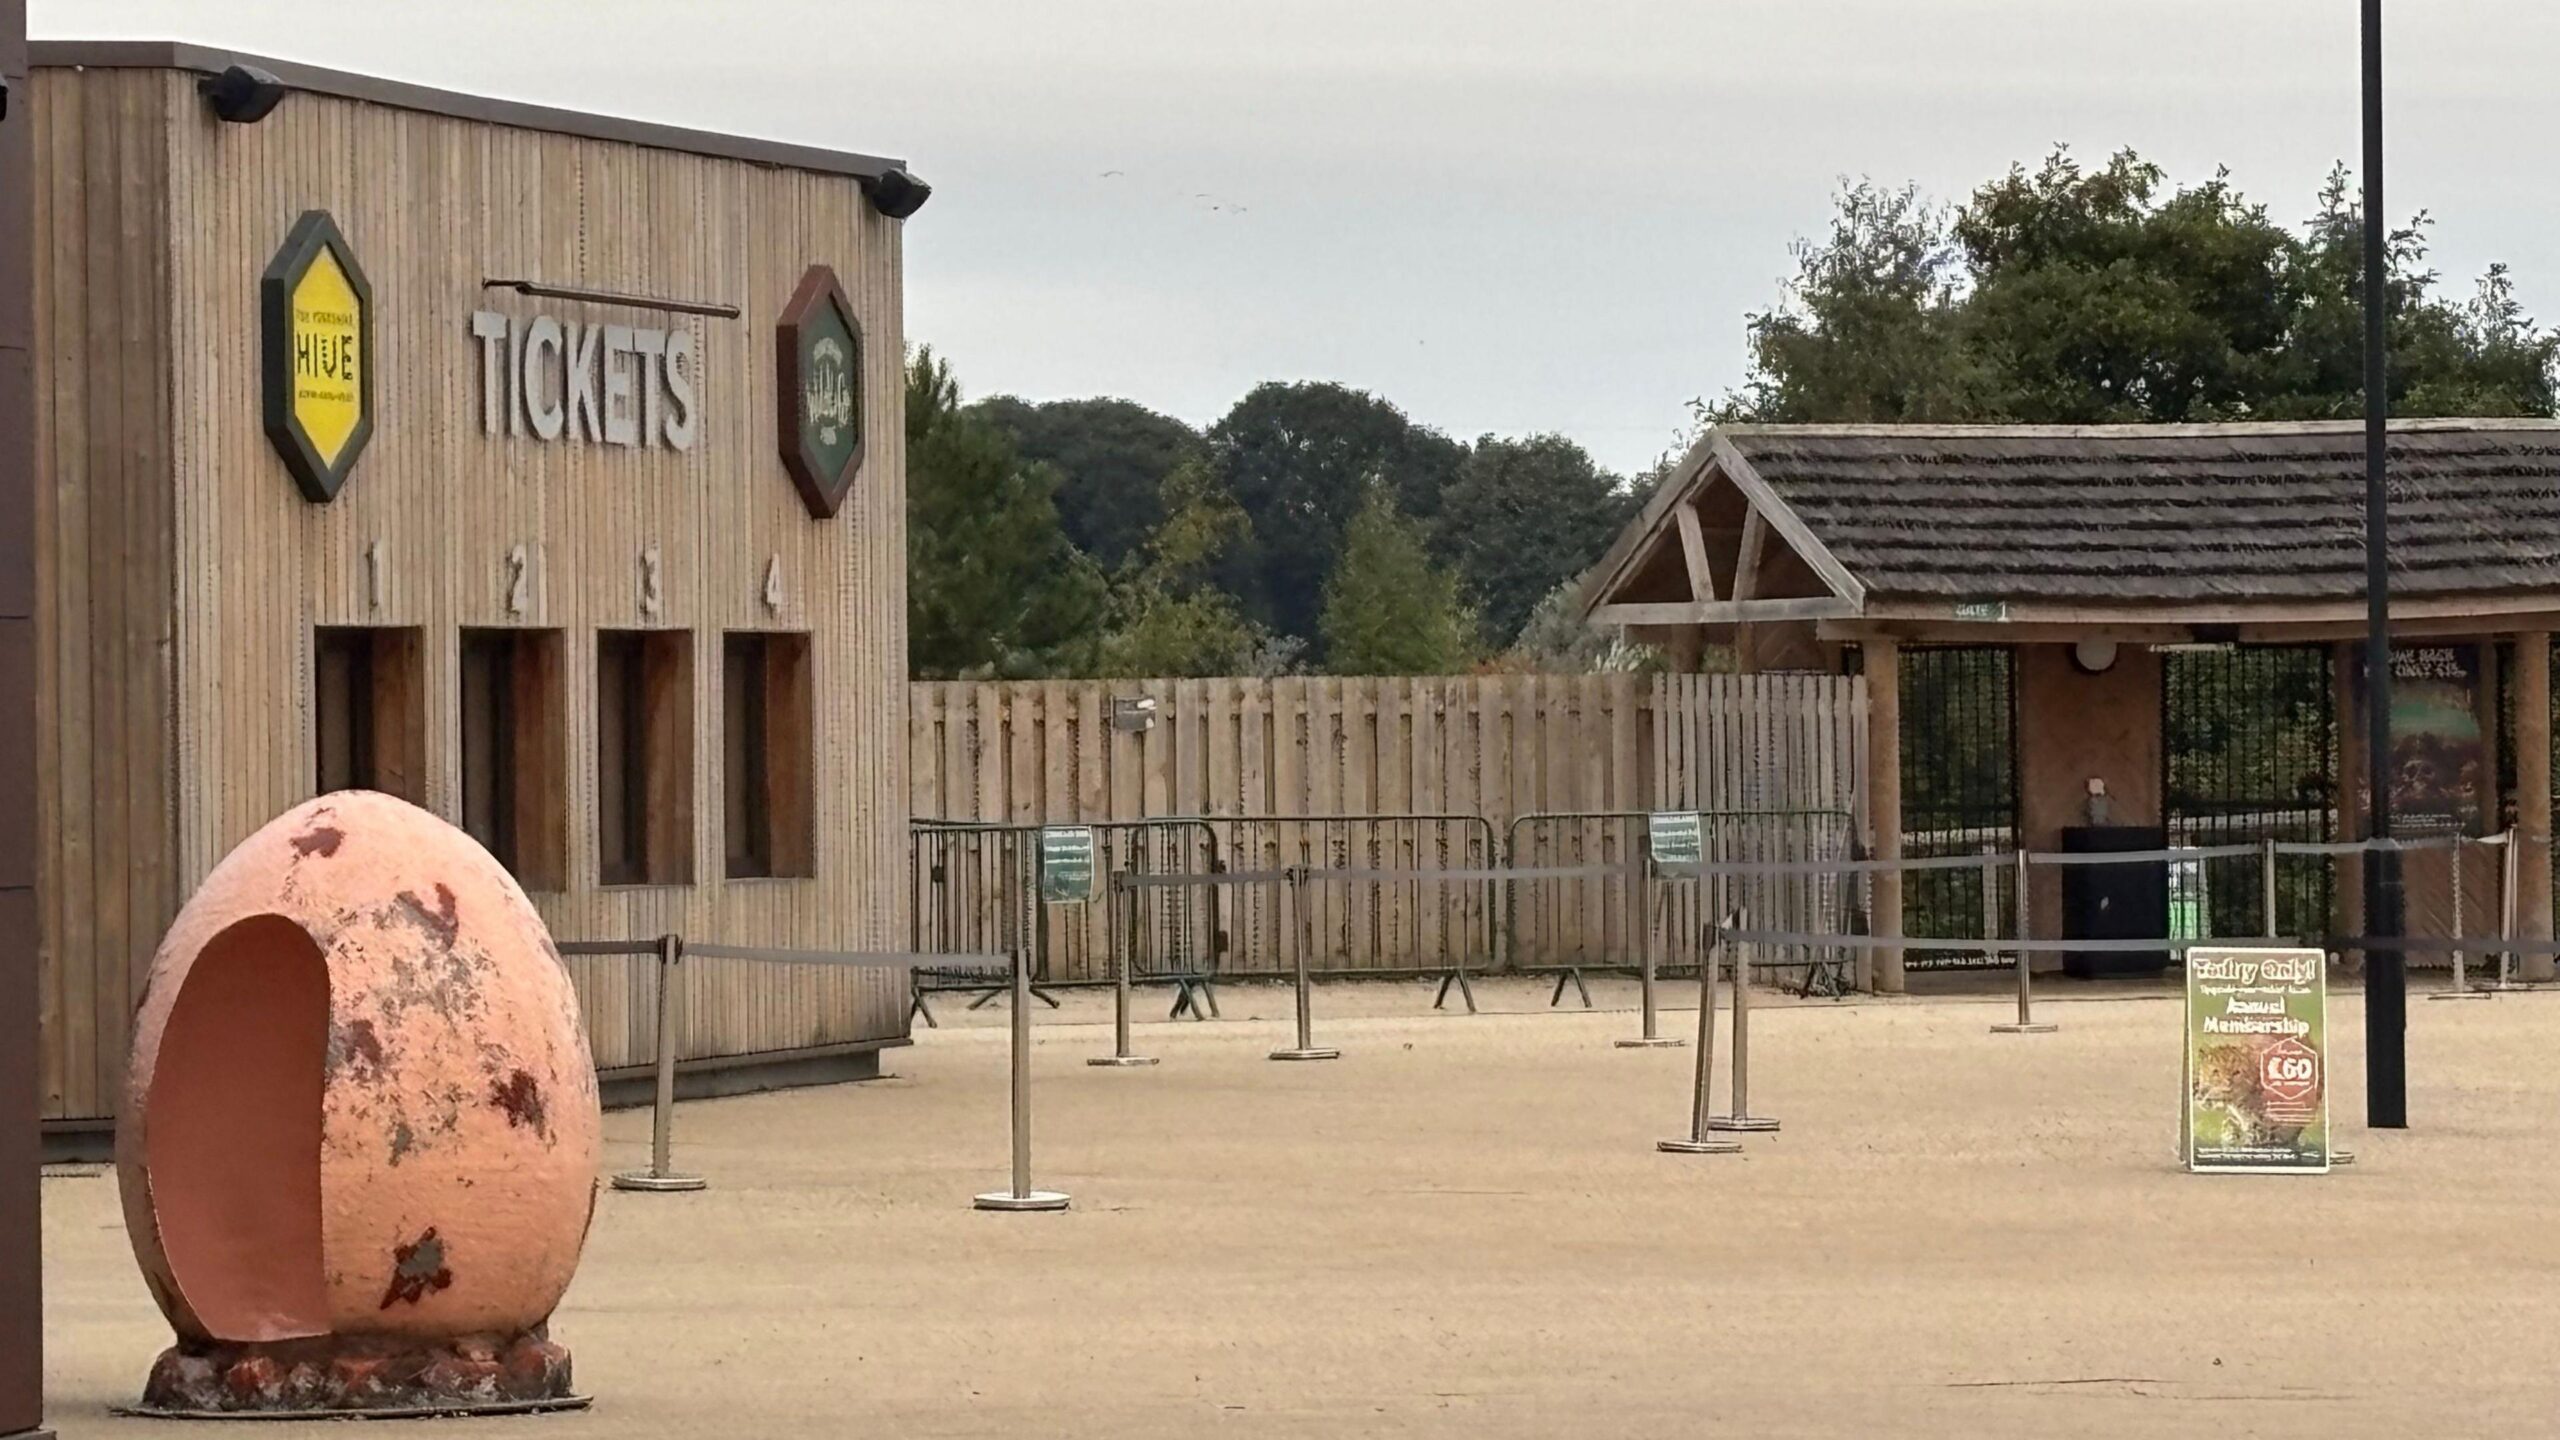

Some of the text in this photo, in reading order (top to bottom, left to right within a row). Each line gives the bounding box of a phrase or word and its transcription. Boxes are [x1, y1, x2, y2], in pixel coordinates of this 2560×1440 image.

[297, 332, 354, 381] HIVE
[472, 311, 697, 451] TICKETS
[506, 544, 530, 618] 2
[640, 549, 662, 617] 3
[764, 552, 784, 617] 4
[2261, 957, 2316, 985] Only!
[2203, 1016, 2310, 1038] Membership
[2226, 996, 2285, 1014] Annual
[2267, 1056, 2313, 1080] £60
